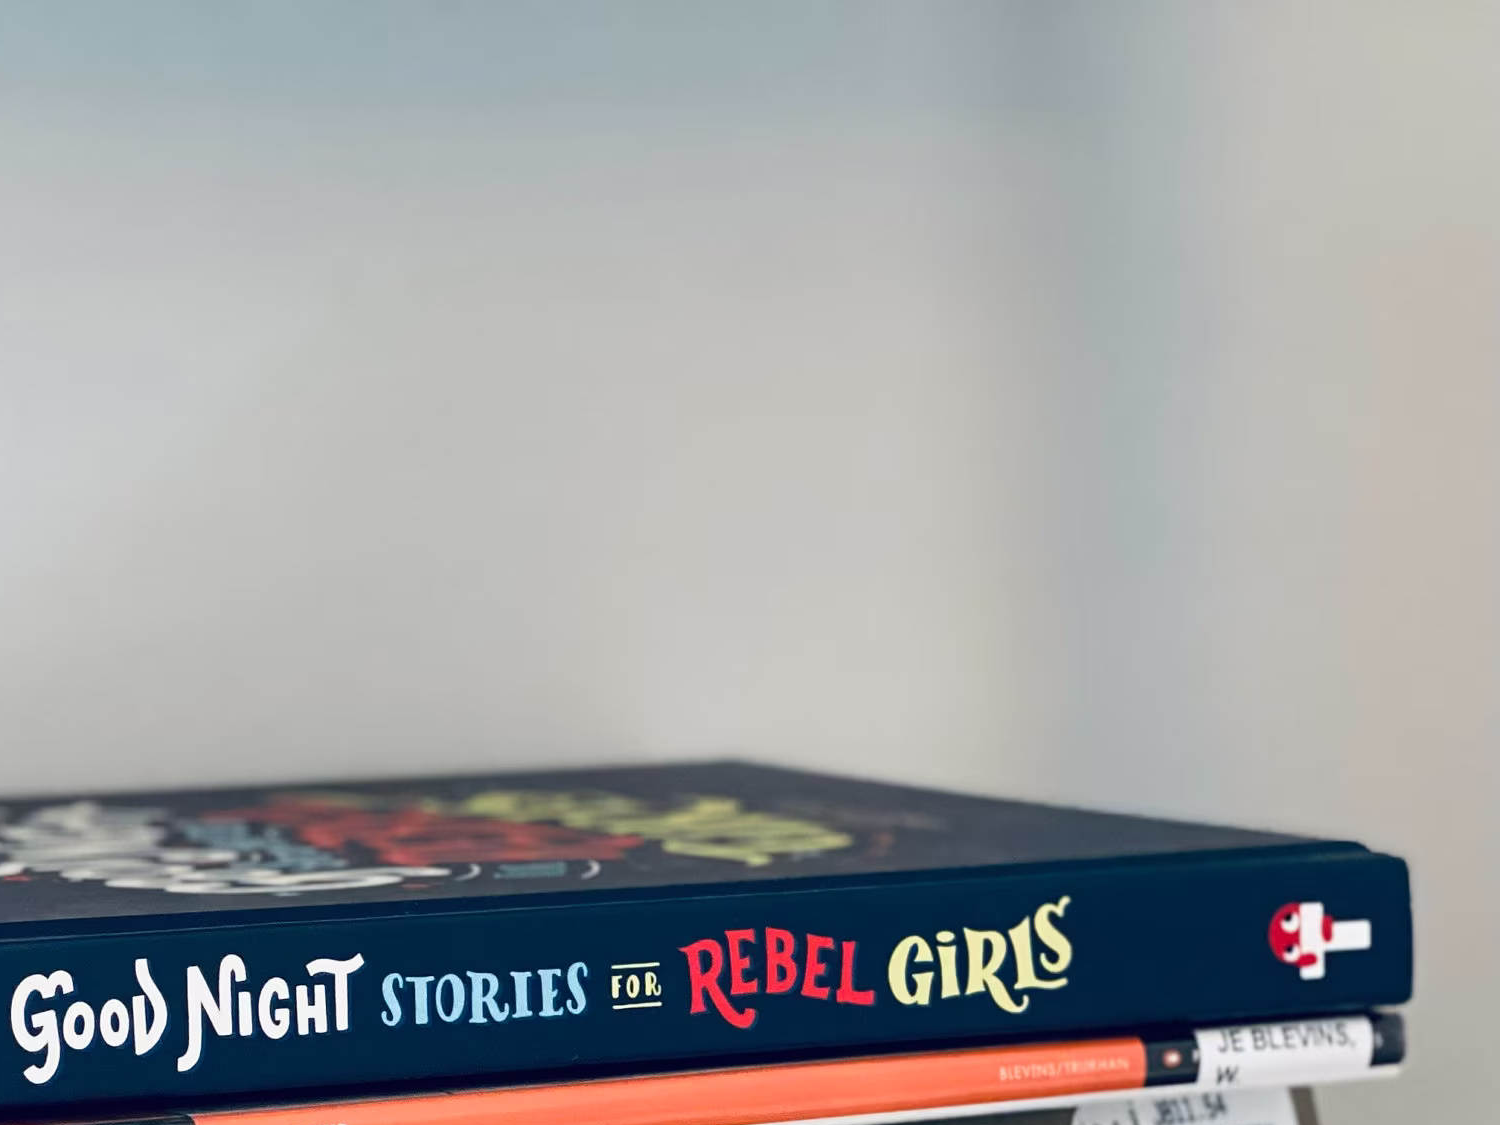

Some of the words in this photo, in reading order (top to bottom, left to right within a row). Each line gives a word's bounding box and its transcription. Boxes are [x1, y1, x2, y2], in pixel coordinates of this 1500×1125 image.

[381, 961, 588, 1027] STORIES
[611, 970, 661, 1000] FOR
[678, 926, 874, 1028] REBEL
[1216, 1029, 1245, 1053] JE
